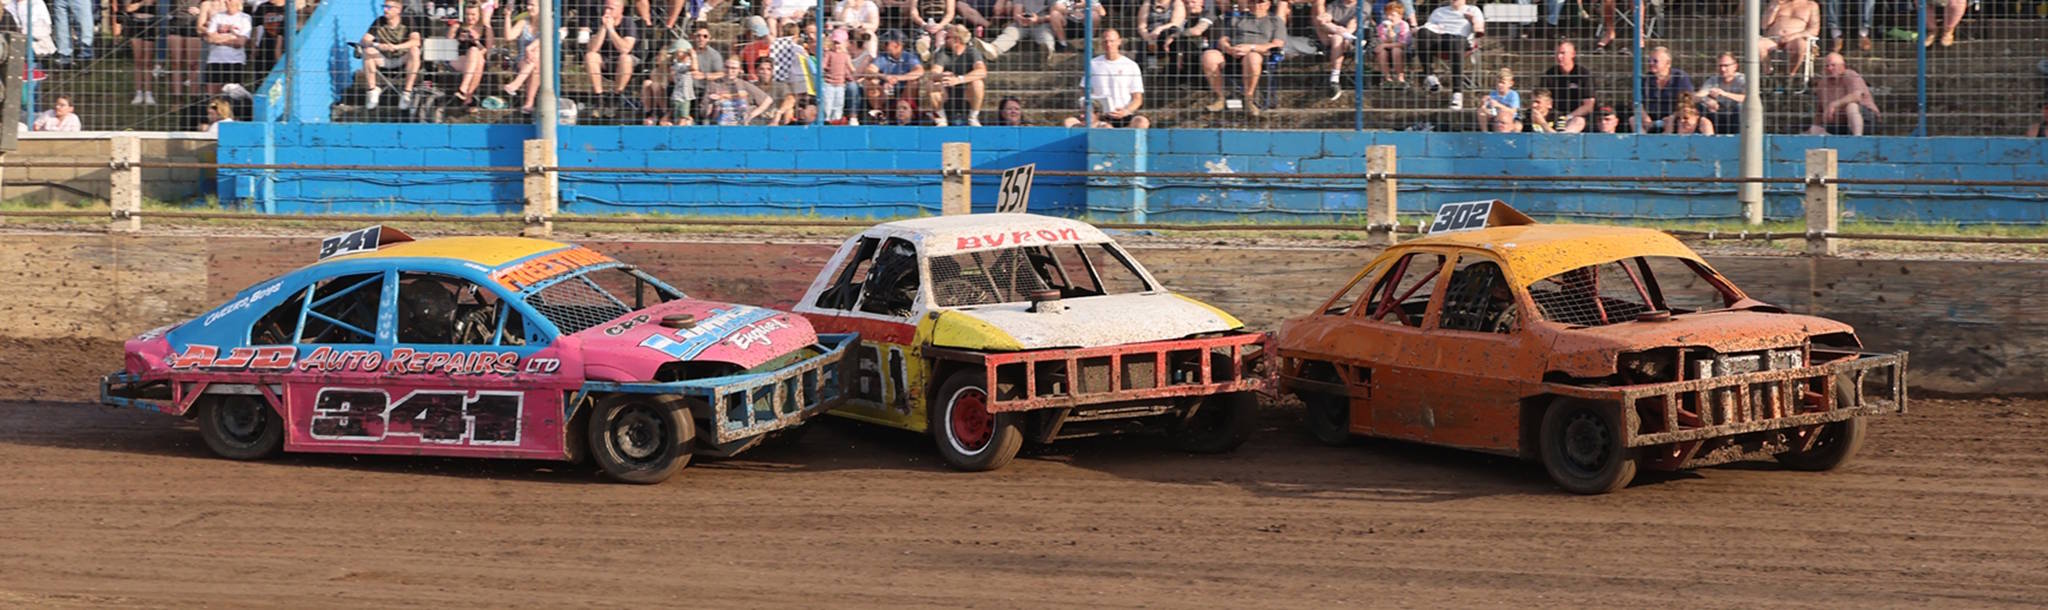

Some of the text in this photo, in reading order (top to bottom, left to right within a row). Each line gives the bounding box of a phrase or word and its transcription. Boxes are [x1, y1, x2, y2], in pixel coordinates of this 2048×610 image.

[999, 165, 1033, 213] 351
[1431, 202, 1491, 232] 302
[320, 227, 380, 259] 341
[172, 344, 561, 375] AJD AUTO REPAIRS LTD
[310, 387, 524, 445] 341
